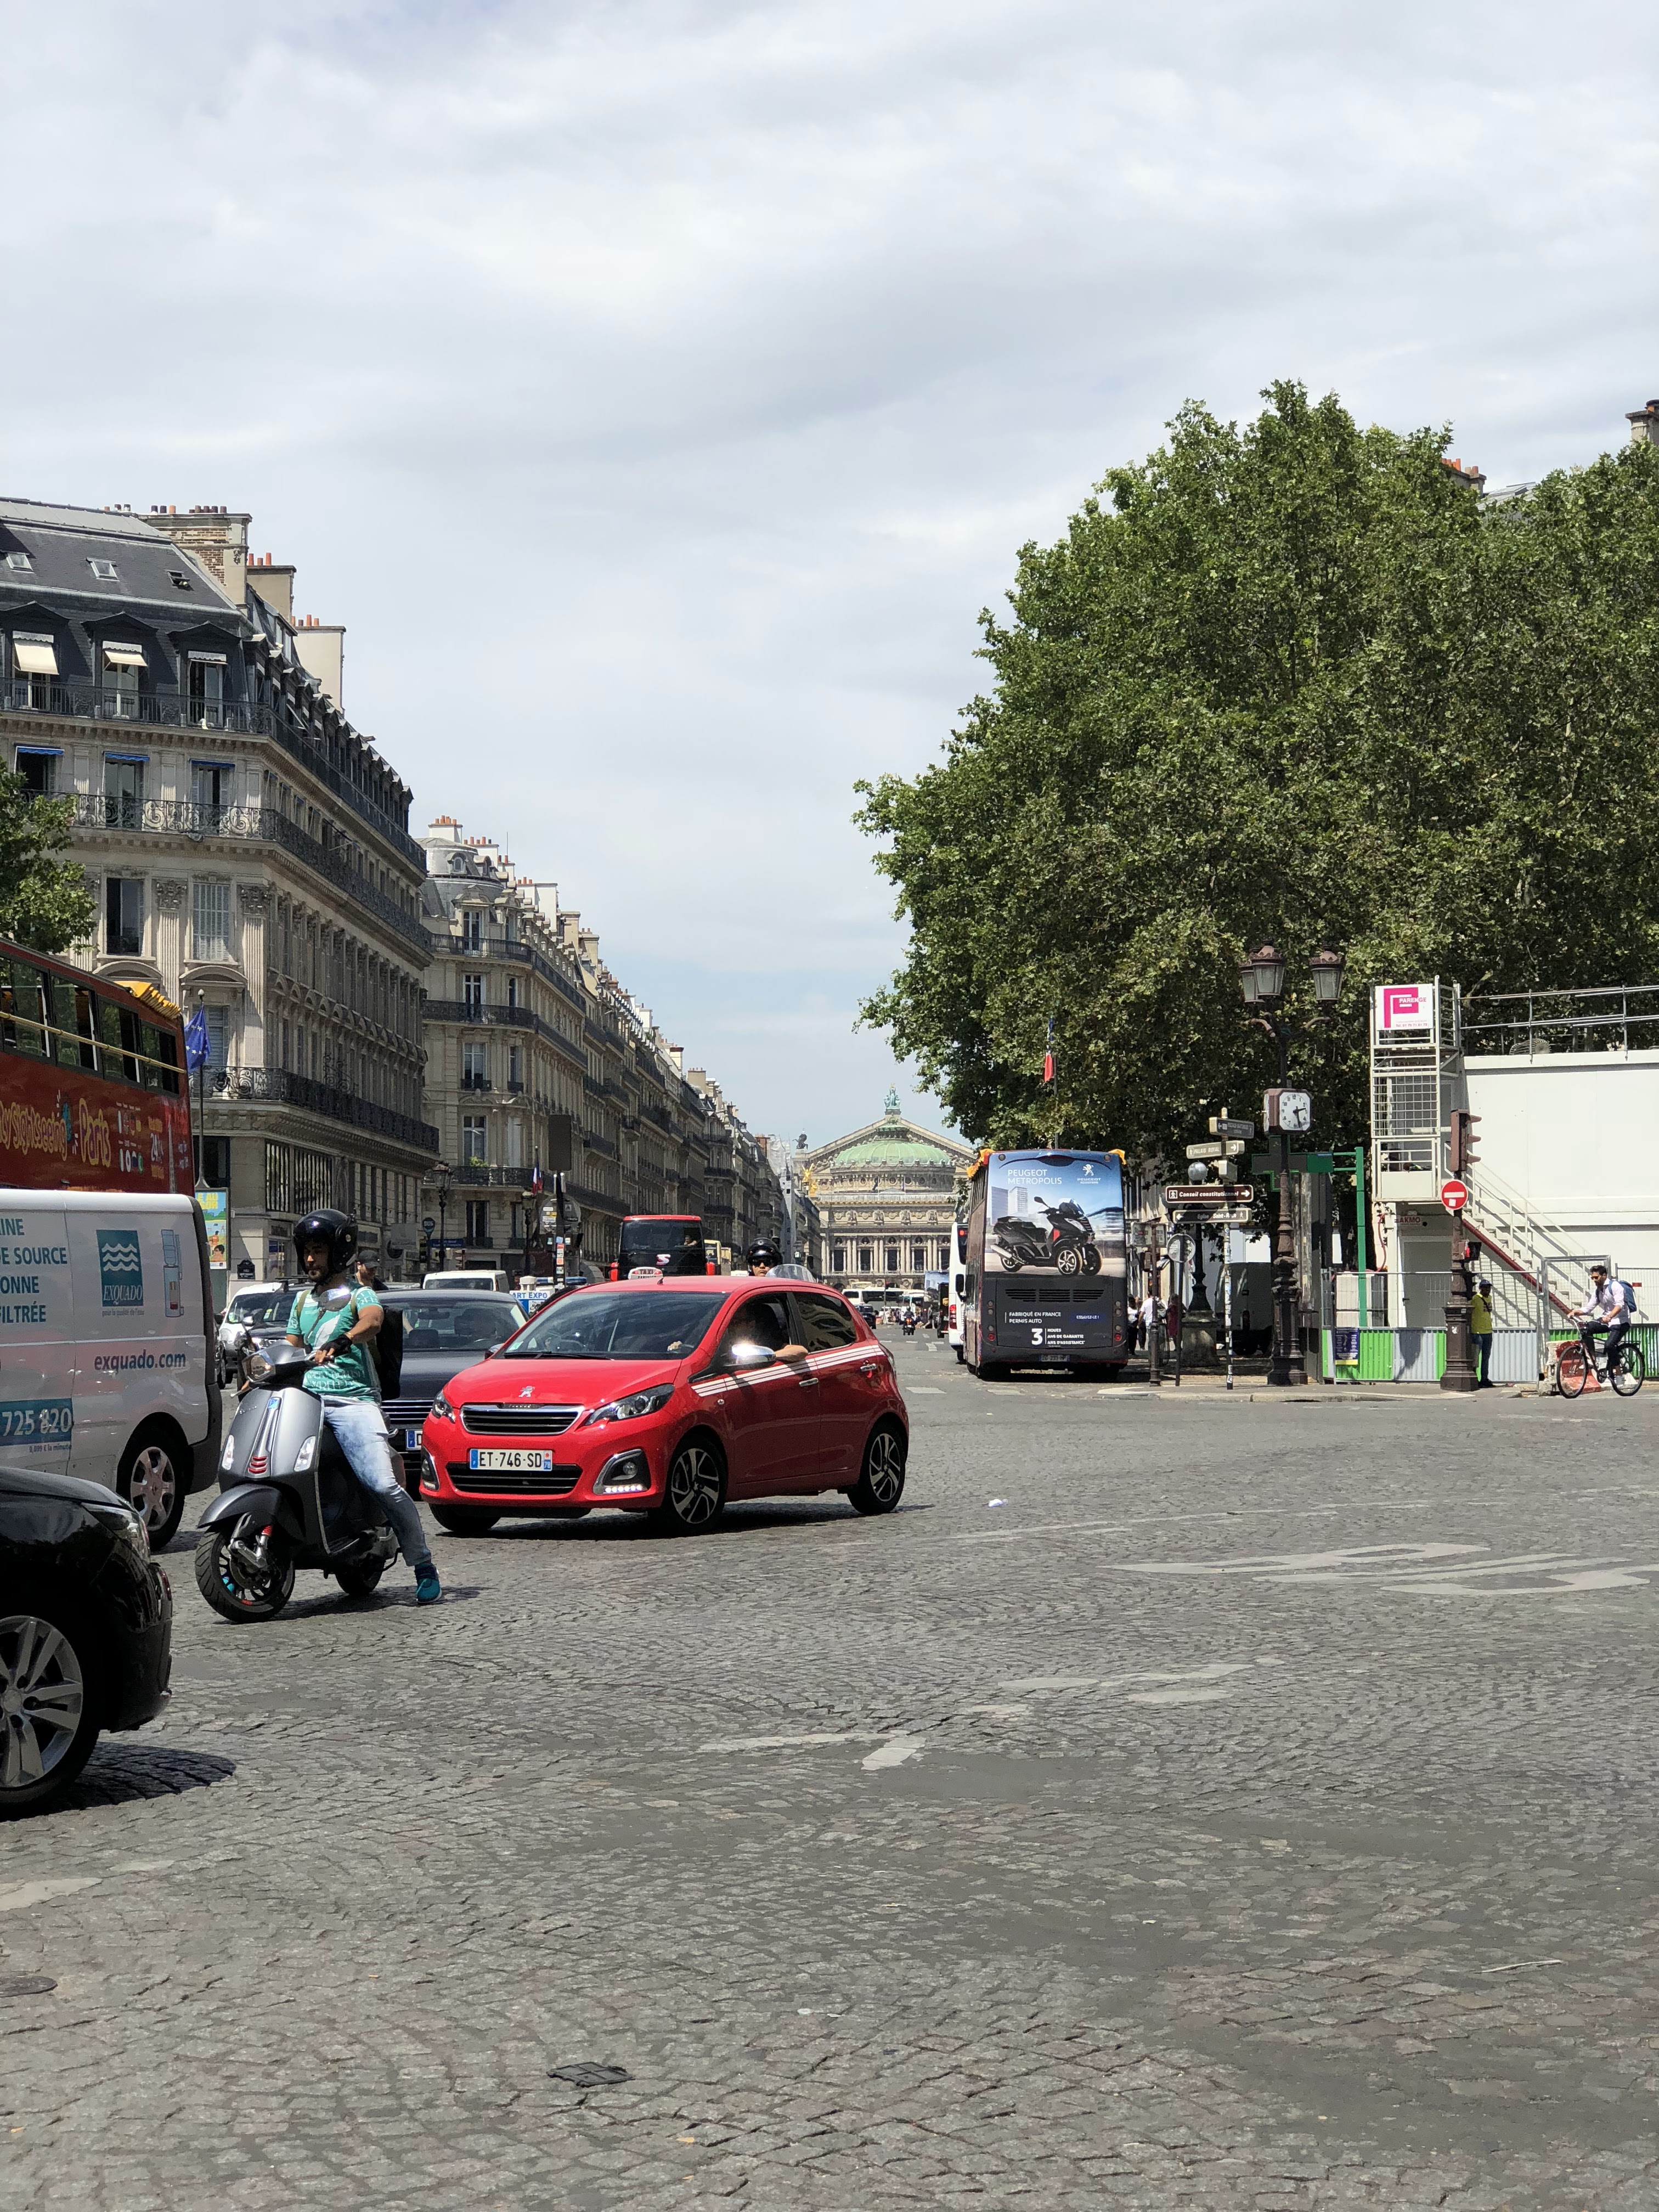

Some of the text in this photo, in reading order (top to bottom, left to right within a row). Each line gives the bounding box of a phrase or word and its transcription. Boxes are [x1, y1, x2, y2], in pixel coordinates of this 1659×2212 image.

[79, 1098, 111, 1168] Paris
[0, 1218, 25, 1235] INE
[14, 1247, 68, 1265] SOURCE
[0, 1276, 40, 1294] ONNE
[104, 1285, 142, 1305] EXQUADO
[1031, 1328, 1043, 1345] 3
[94, 1349, 186, 1374] exquado.com
[2, 1408, 72, 1436] 725 820
[479, 1452, 541, 1468] ET-746-SD
